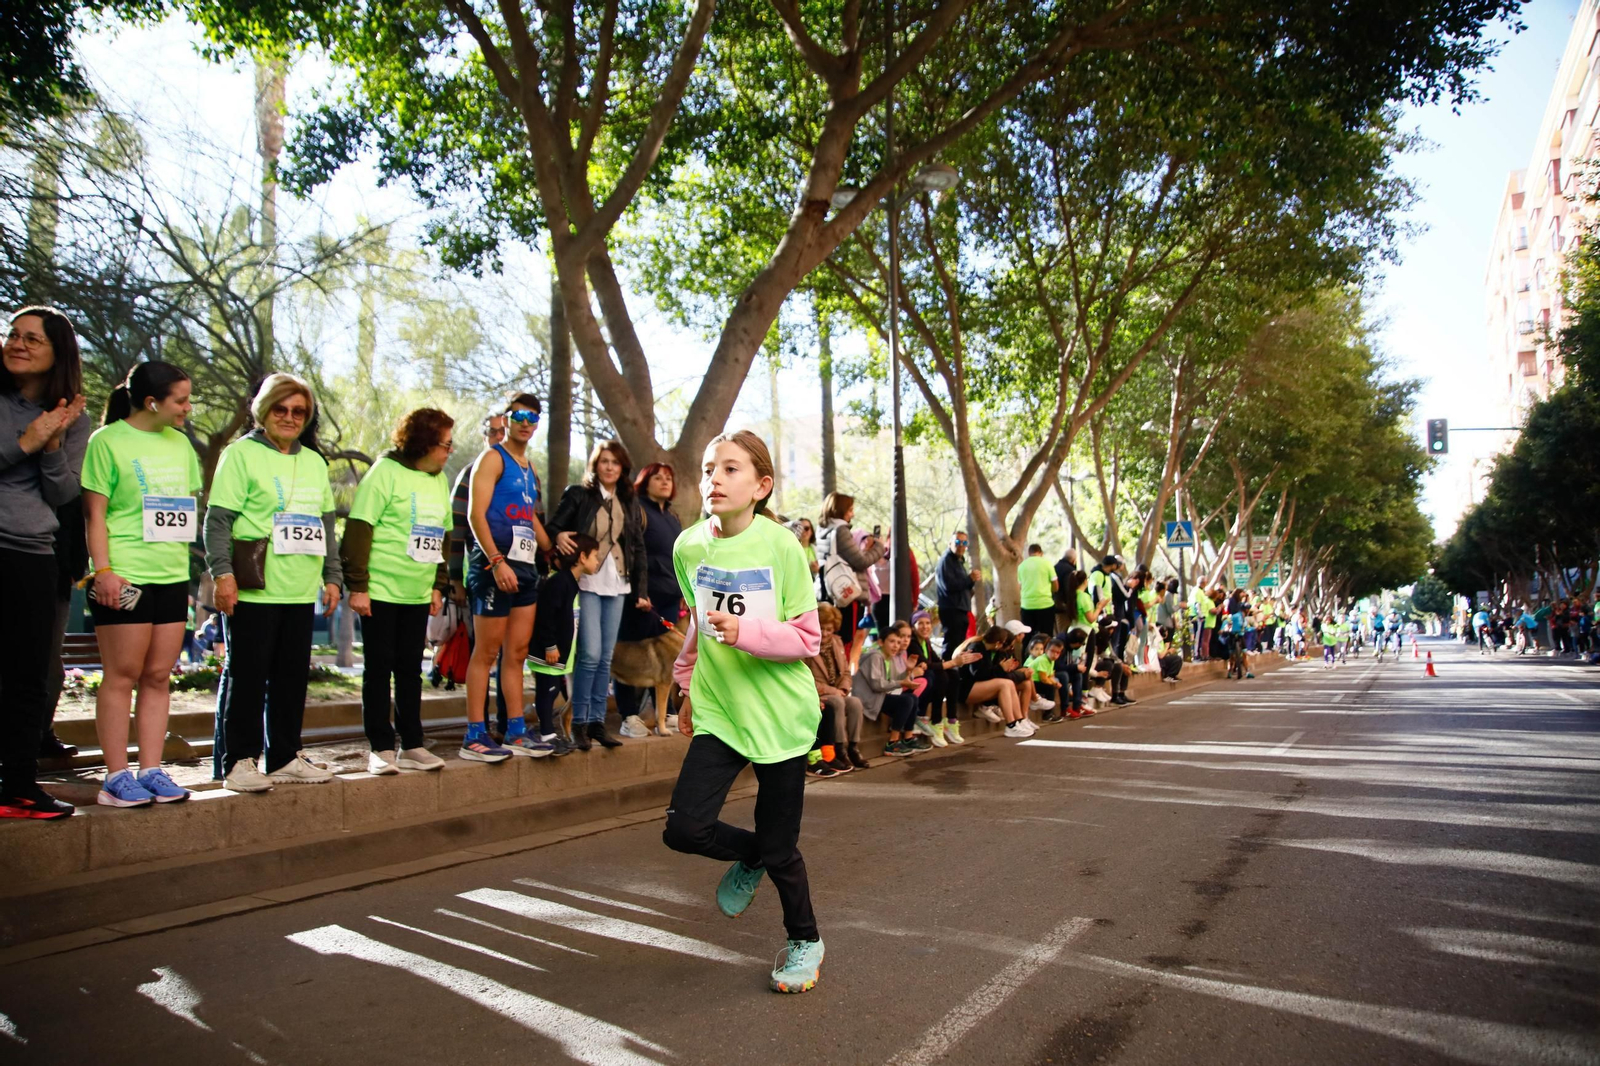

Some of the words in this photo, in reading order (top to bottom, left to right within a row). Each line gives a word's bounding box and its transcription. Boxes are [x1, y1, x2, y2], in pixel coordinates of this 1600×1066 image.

[155, 511, 187, 527] 829
[280, 526, 323, 541] 1524
[712, 591, 746, 617] 76
